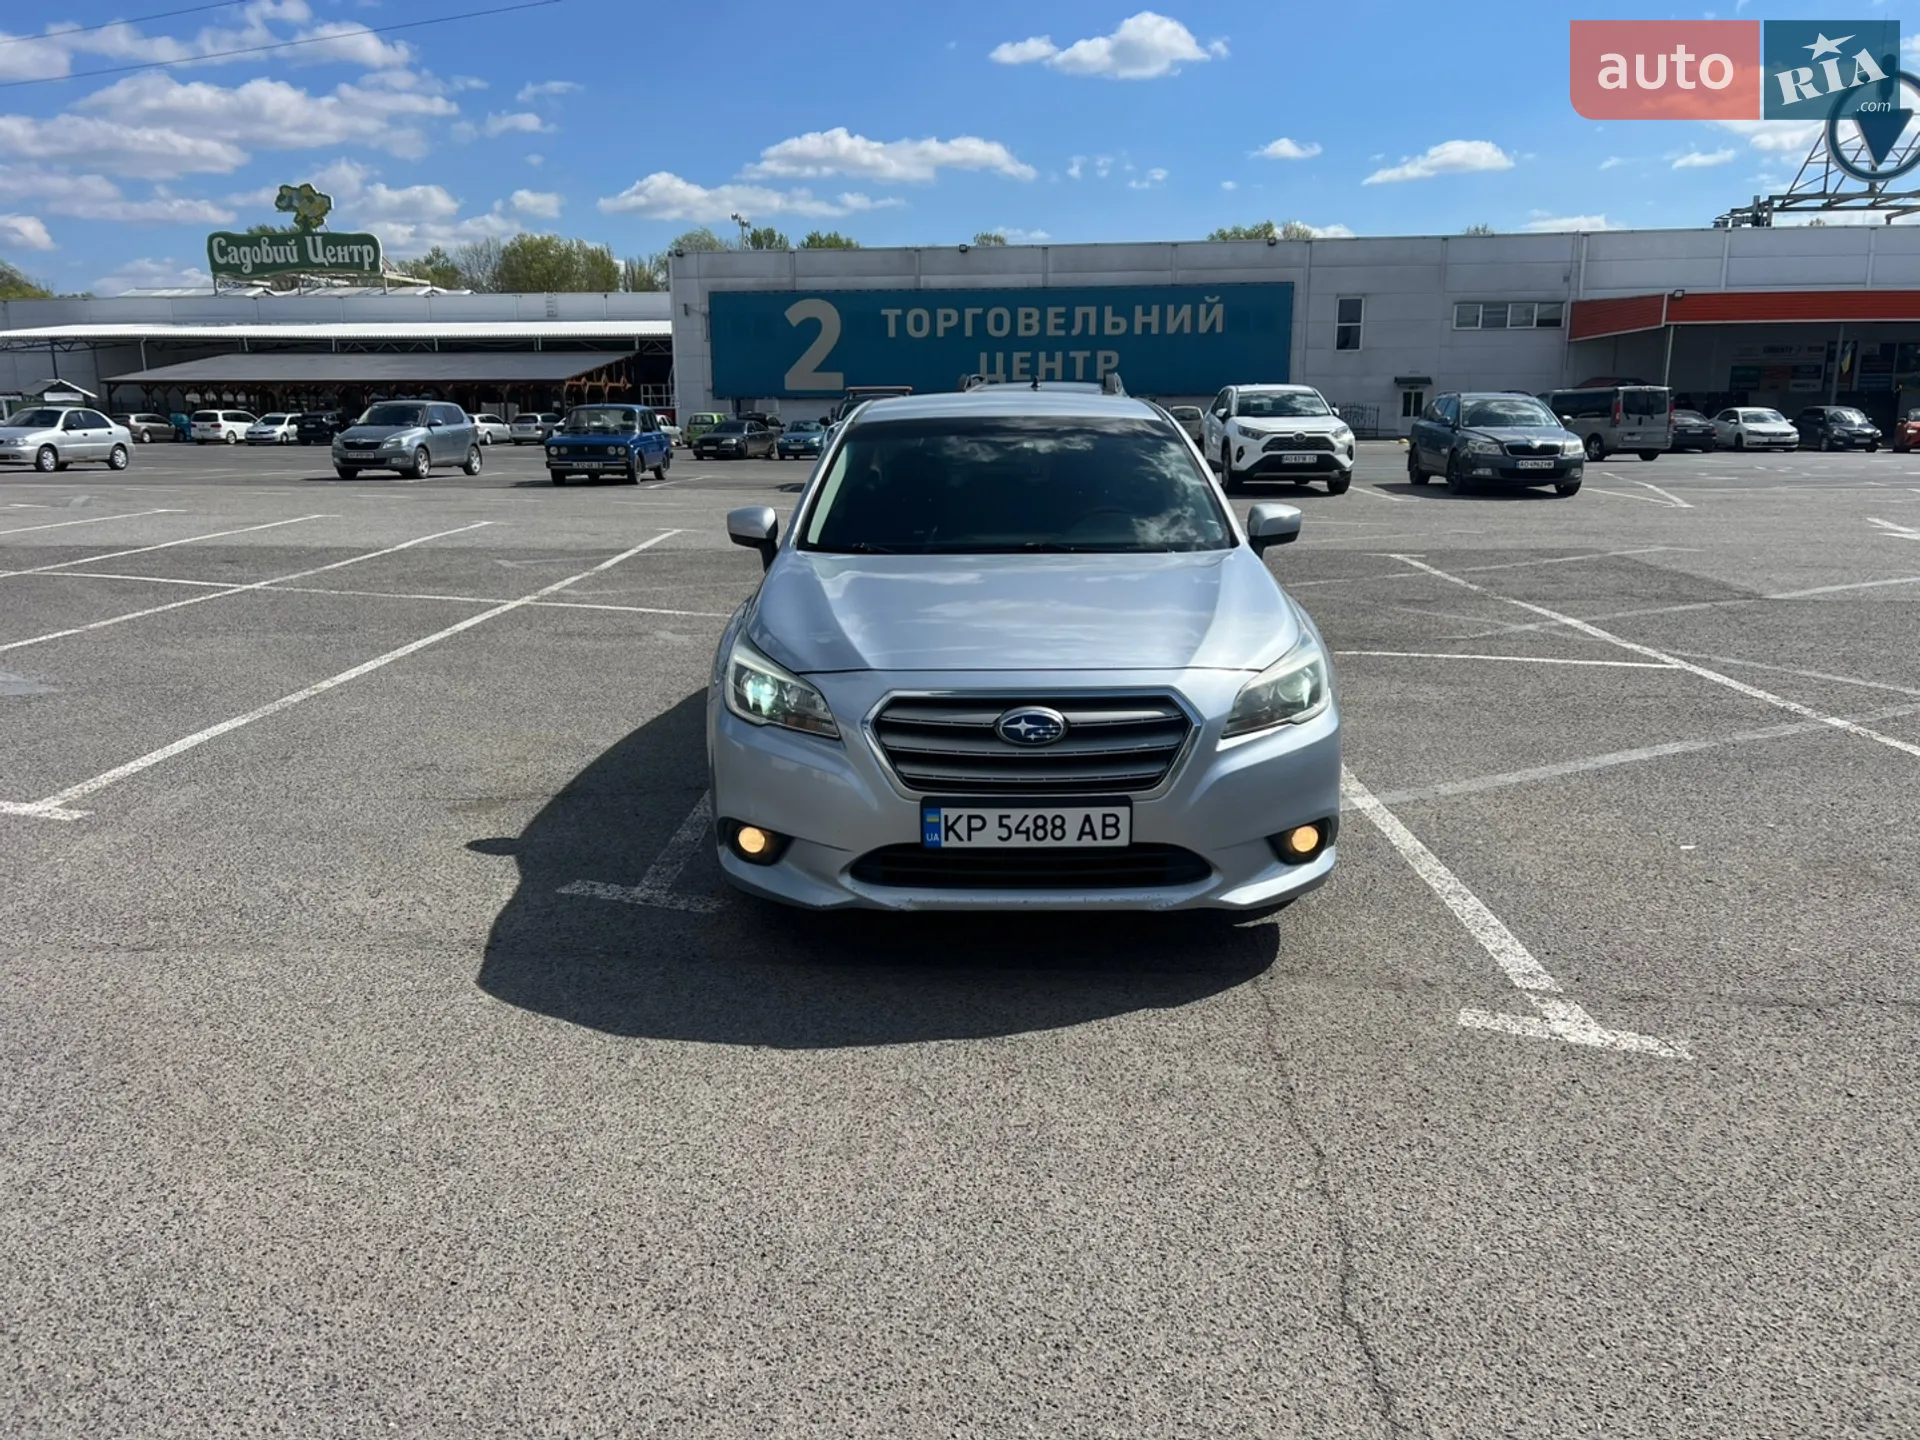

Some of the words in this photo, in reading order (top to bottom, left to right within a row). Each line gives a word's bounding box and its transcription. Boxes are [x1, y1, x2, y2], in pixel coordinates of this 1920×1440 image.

[212, 237, 299, 274] Садовий
[305, 236, 375, 270] Центр
[881, 296, 1225, 338] ТОРГОВЕЛЬНИЙ
[784, 299, 844, 391] 2
[979, 350, 1120, 382] ЦЕНТР
[926, 833, 940, 842] UA
[944, 814, 987, 842] KP
[997, 814, 1066, 842] 5488
[1077, 813, 1121, 841] AB
